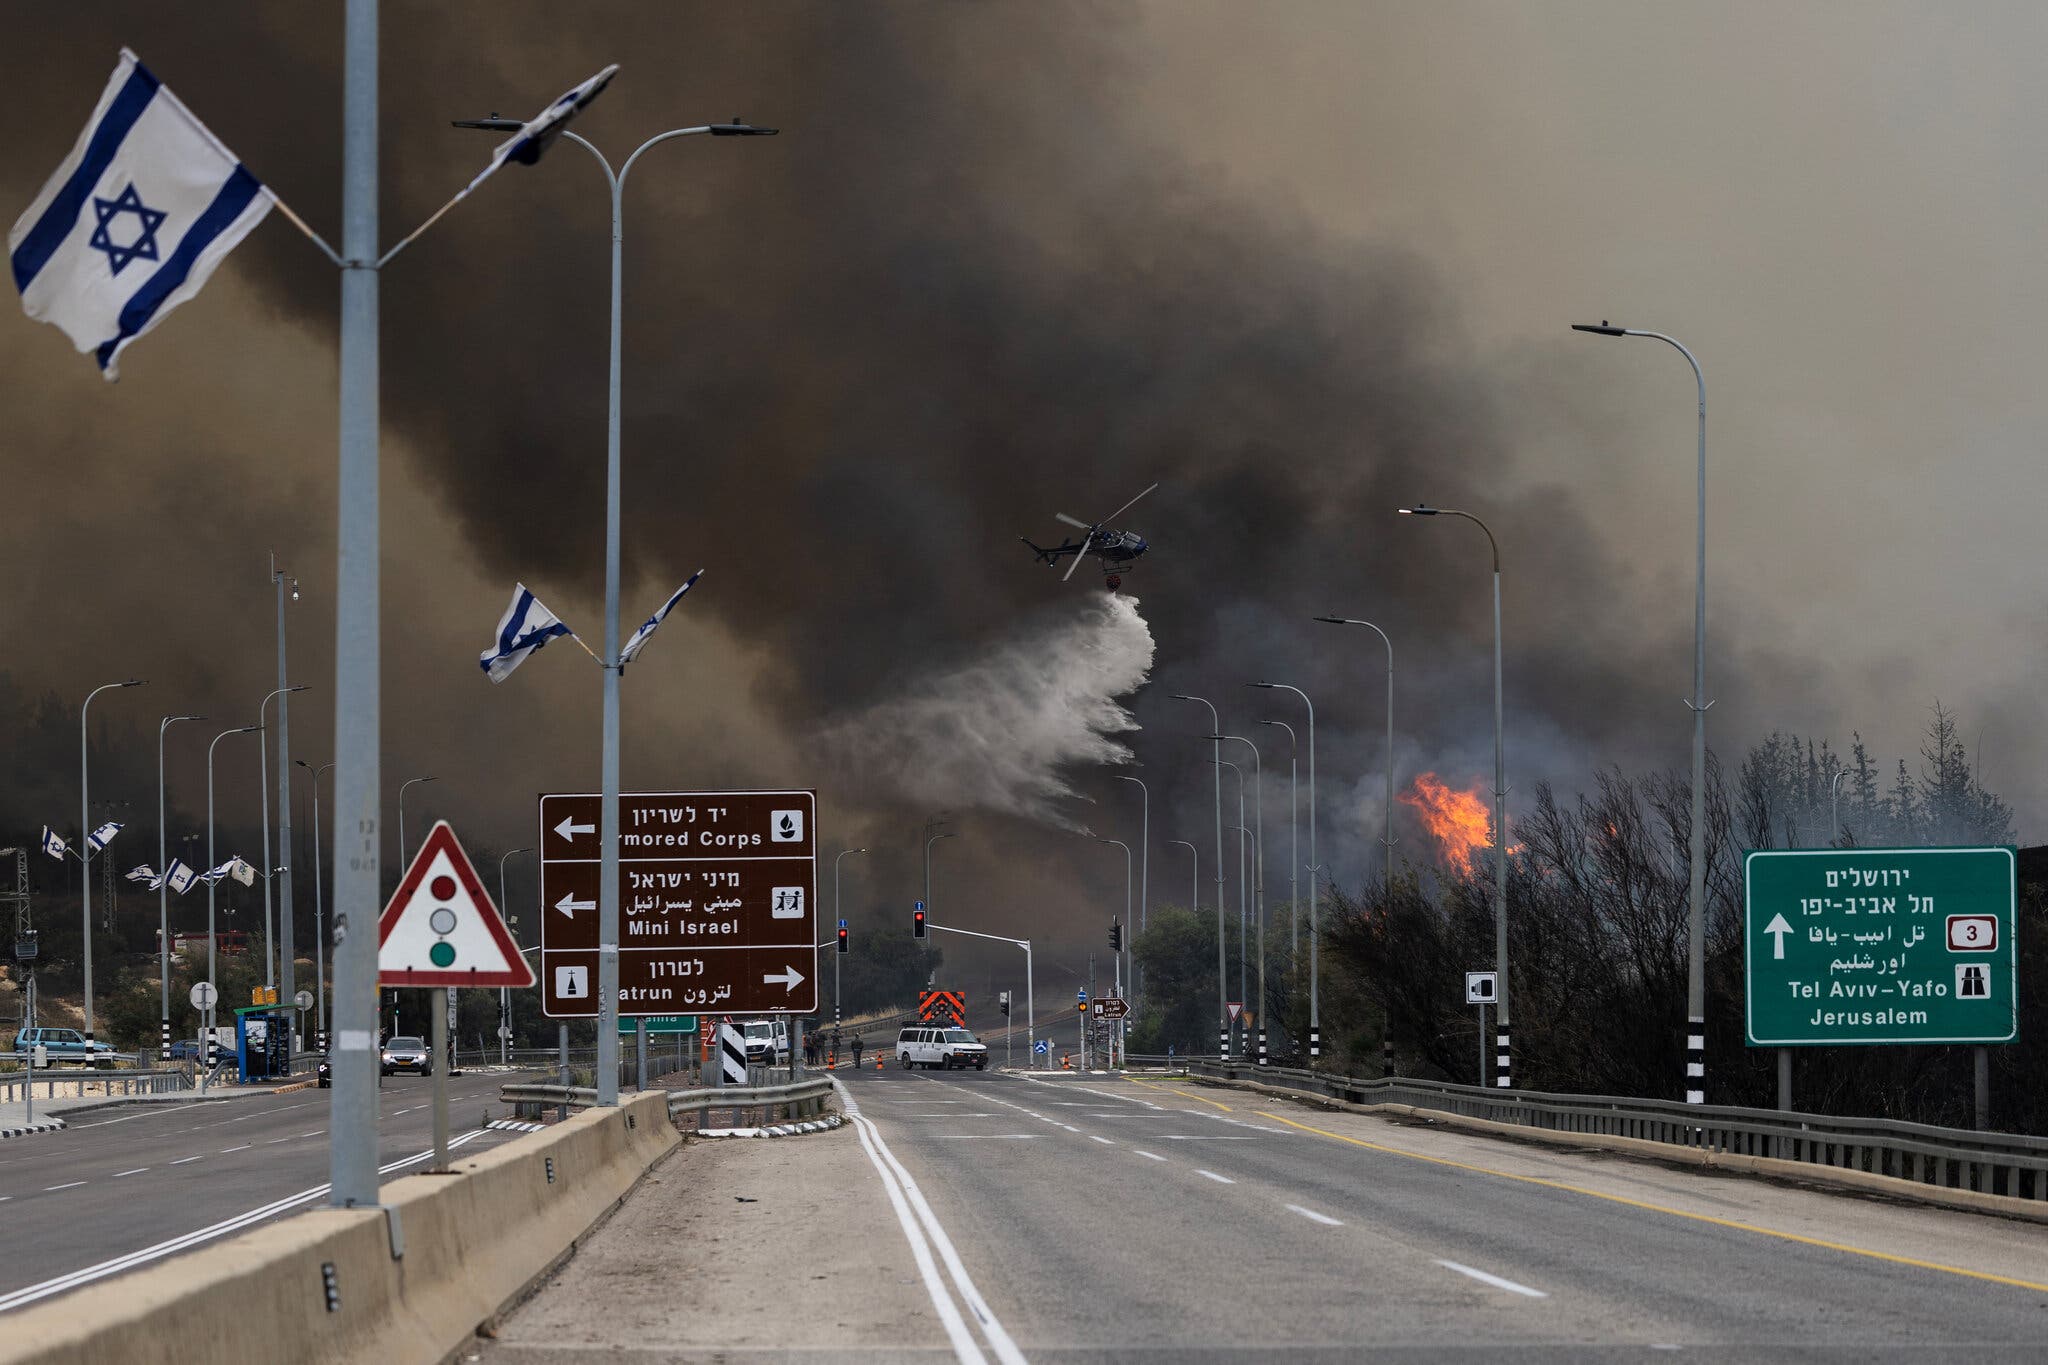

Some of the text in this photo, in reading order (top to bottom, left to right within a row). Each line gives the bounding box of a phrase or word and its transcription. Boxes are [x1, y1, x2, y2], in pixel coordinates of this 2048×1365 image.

[632, 806, 727, 826] יד לשריון
[600, 831, 762, 849] mored Corps
[629, 871, 740, 888] מיני ישראל
[1826, 868, 1910, 888] ירושלים
[626, 894, 742, 915] ميني يسرائيل
[1800, 894, 1934, 915] תל אביב-יפו
[629, 919, 738, 935] Mini Israel
[1903, 925, 1925, 948] تل
[1966, 925, 1978, 941] 3
[649, 958, 704, 979] לטרון
[1830, 953, 1906, 976] اورشليم
[618, 986, 673, 1000] atrun
[684, 984, 732, 1004] لترون
[1788, 981, 1820, 998] Tel
[1810, 1008, 1928, 1026] Jerusalem
